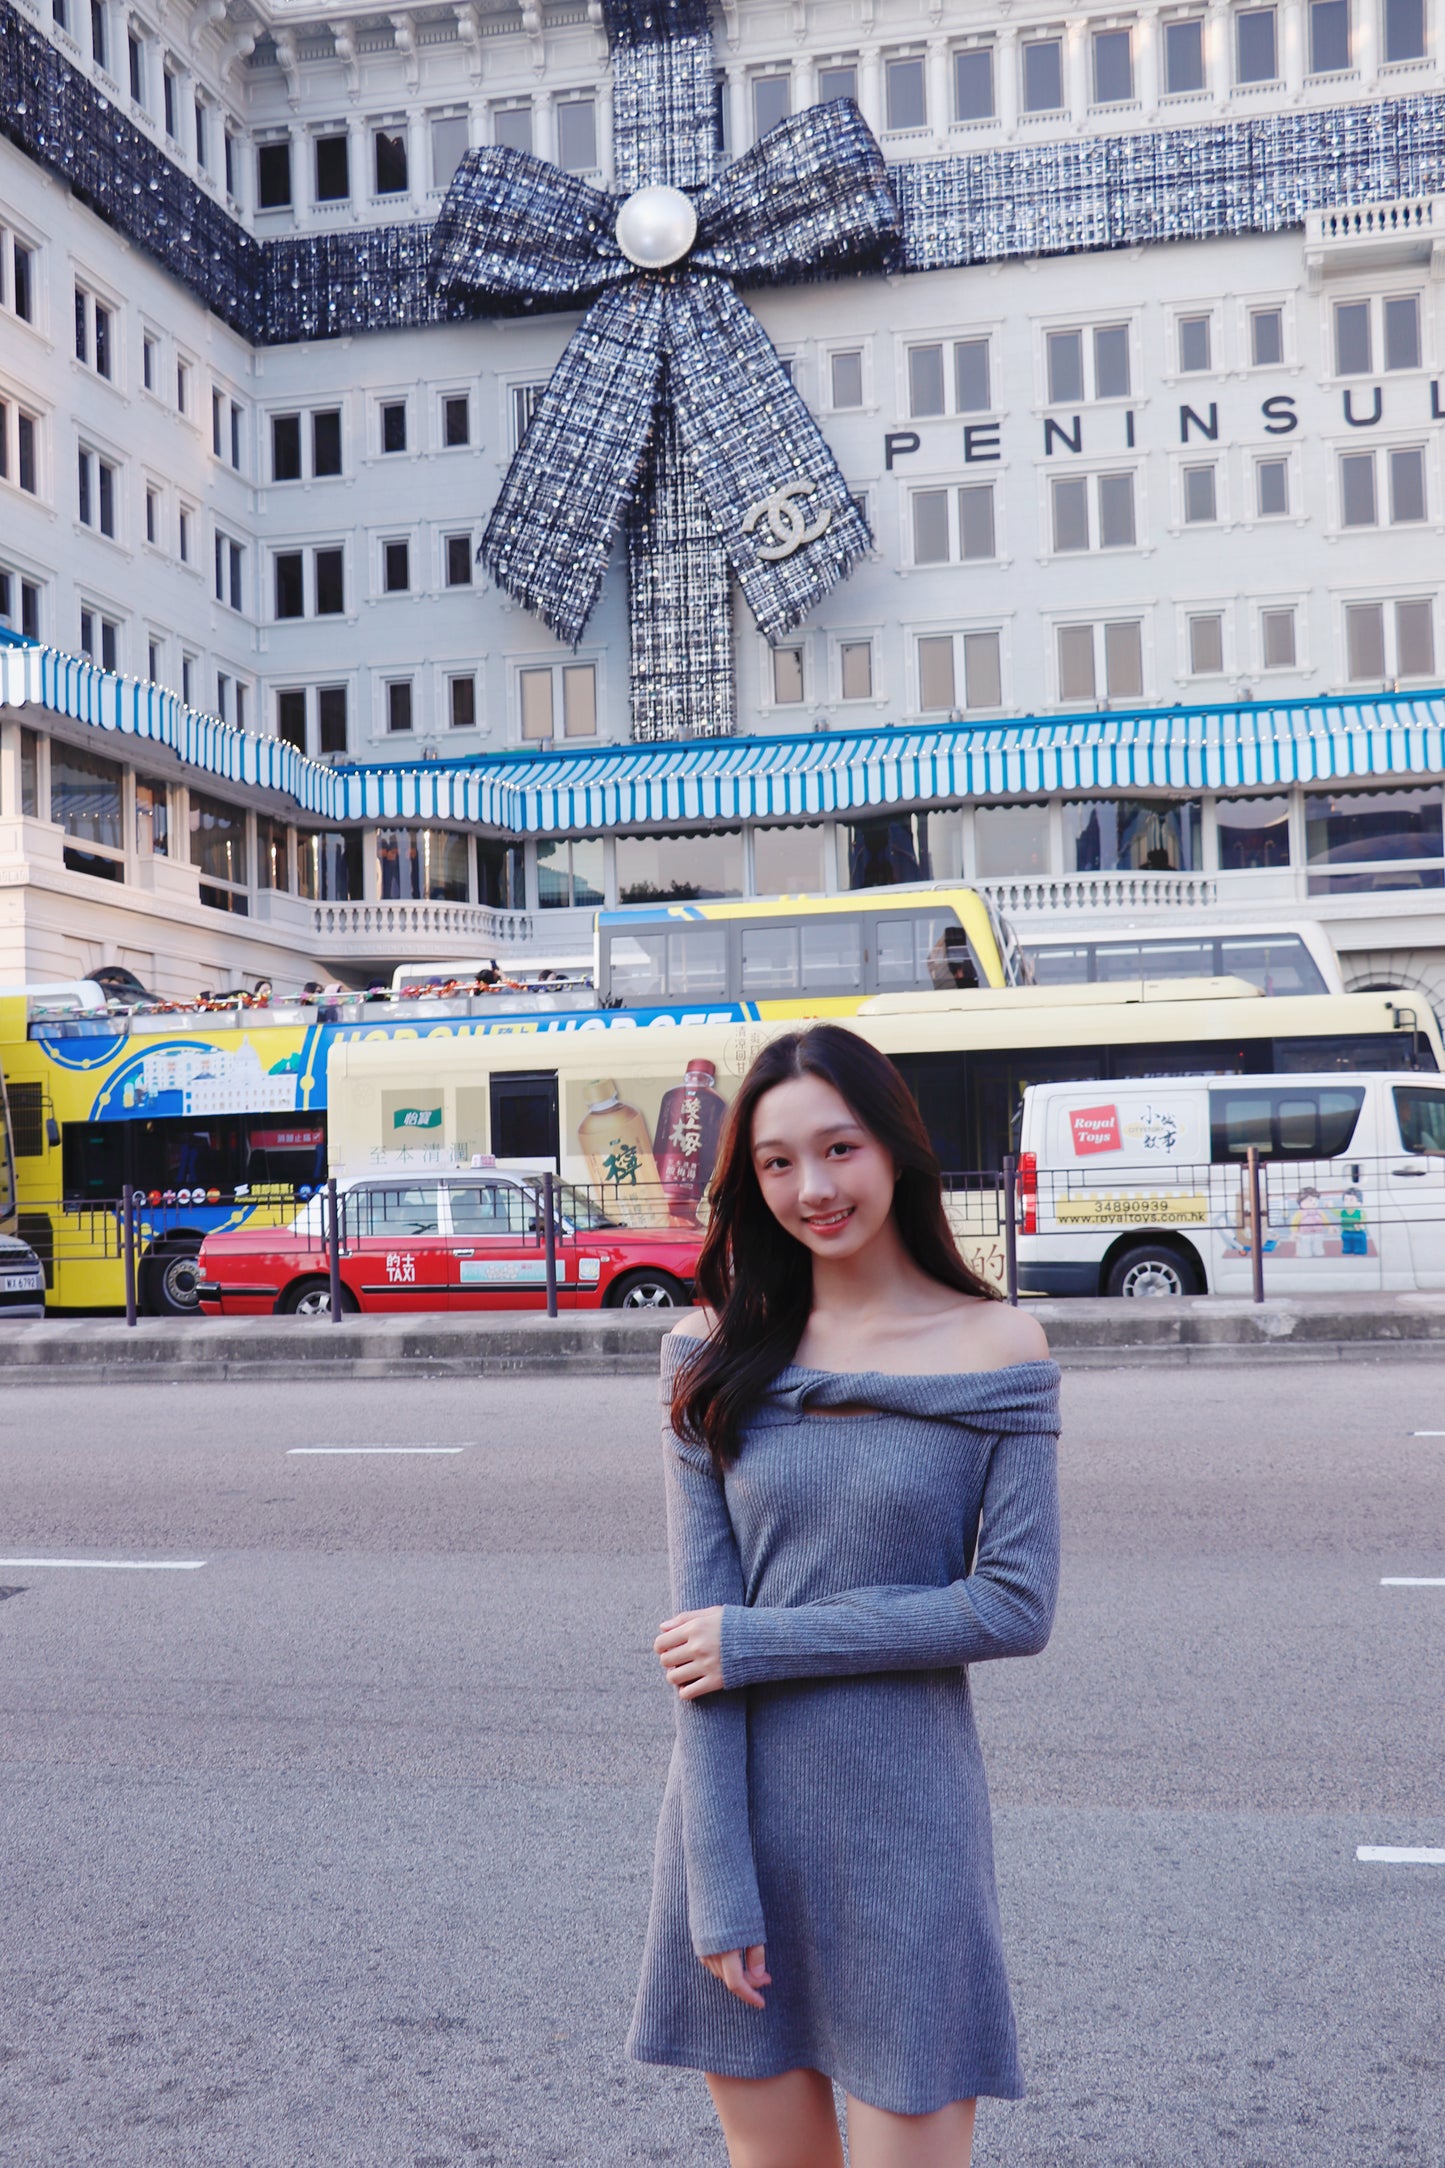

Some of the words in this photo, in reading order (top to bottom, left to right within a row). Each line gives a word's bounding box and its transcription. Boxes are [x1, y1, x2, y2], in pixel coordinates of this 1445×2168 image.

[884, 380, 1445, 470] PENINSUL
[1074, 1117, 1115, 1131] Royal
[1078, 1132, 1111, 1144] Toys
[1094, 1200, 1168, 1212] 34890939
[1058, 1212, 1205, 1225] www.royaltoys.com.hk
[386, 1253, 415, 1268] 的士
[386, 1267, 415, 1282] TAXI
